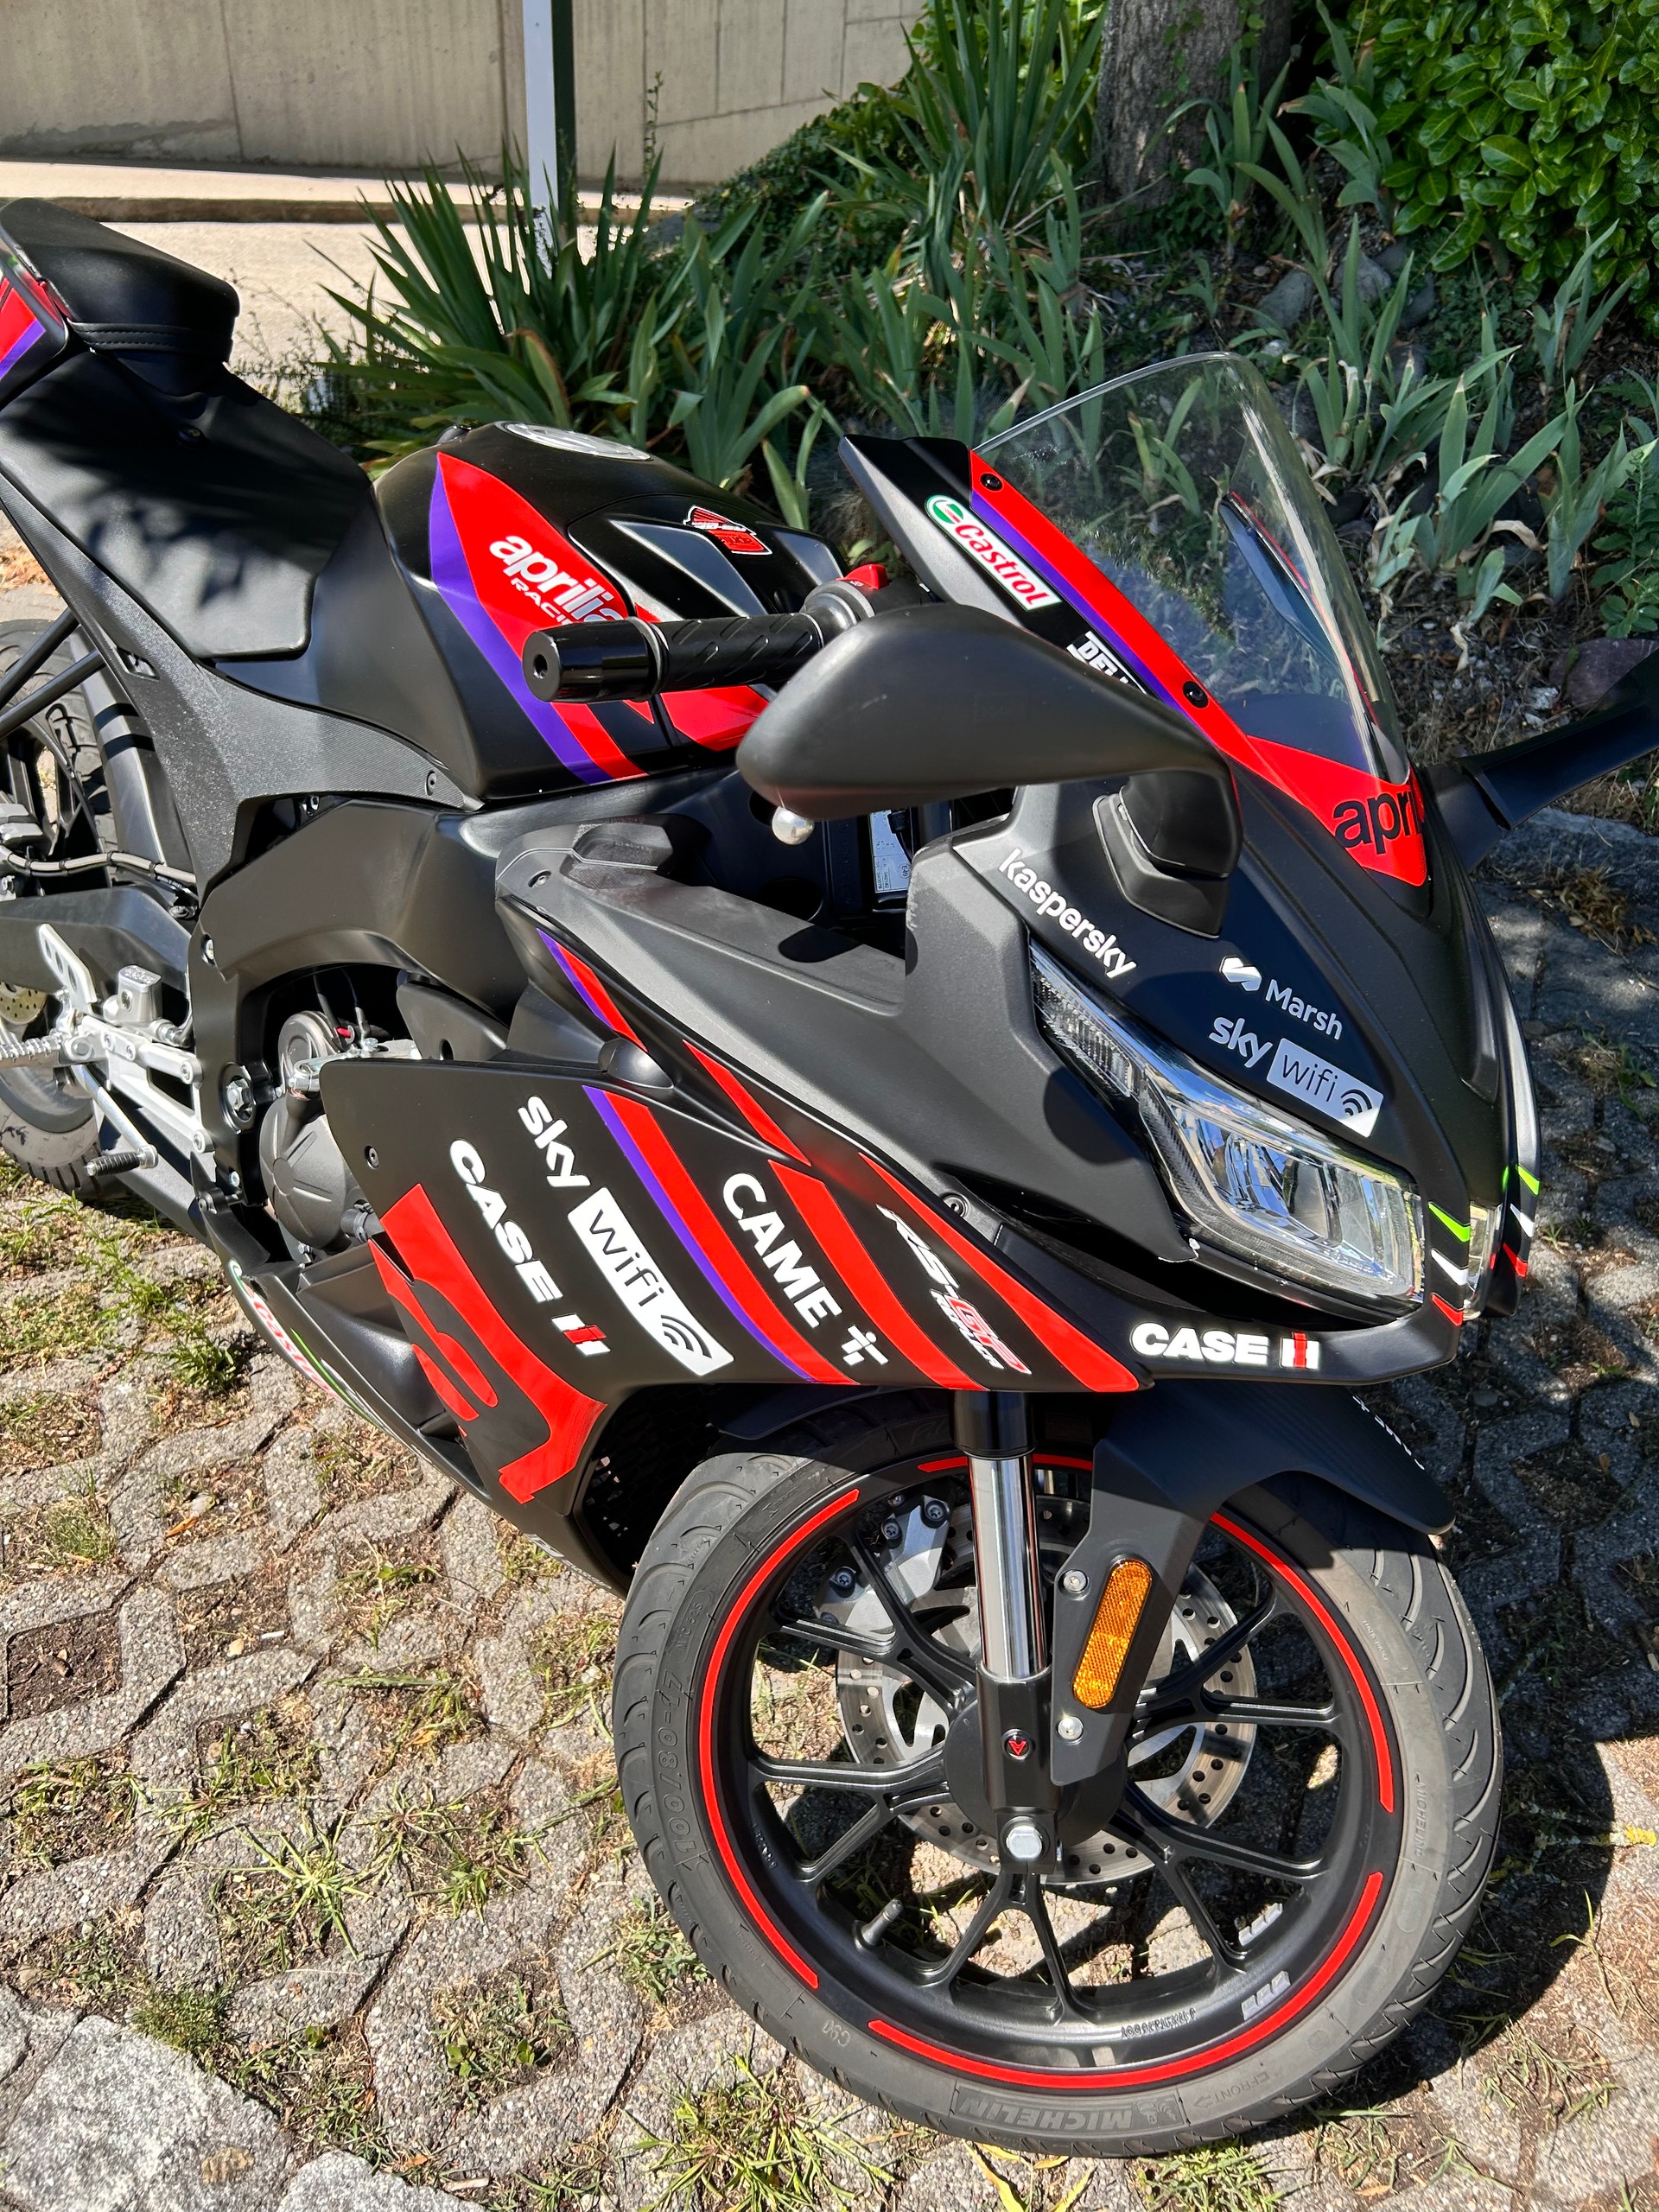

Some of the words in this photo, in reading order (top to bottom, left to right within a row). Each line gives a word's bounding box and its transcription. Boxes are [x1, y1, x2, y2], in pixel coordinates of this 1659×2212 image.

[955, 524, 1050, 605] Castrol
[998, 848, 1138, 979] kaspersky
[1265, 978, 1343, 1040] Marsh
[1208, 1016, 1274, 1068] sky
[1282, 1054, 1338, 1103] wifi
[449, 1140, 563, 1303] CASE
[518, 1096, 590, 1187] sky
[588, 1208, 664, 1307] wifi
[722, 1173, 842, 1329] CAME
[1131, 1322, 1269, 1366] CASE
[959, 2095, 1133, 2130] MICHELIN
